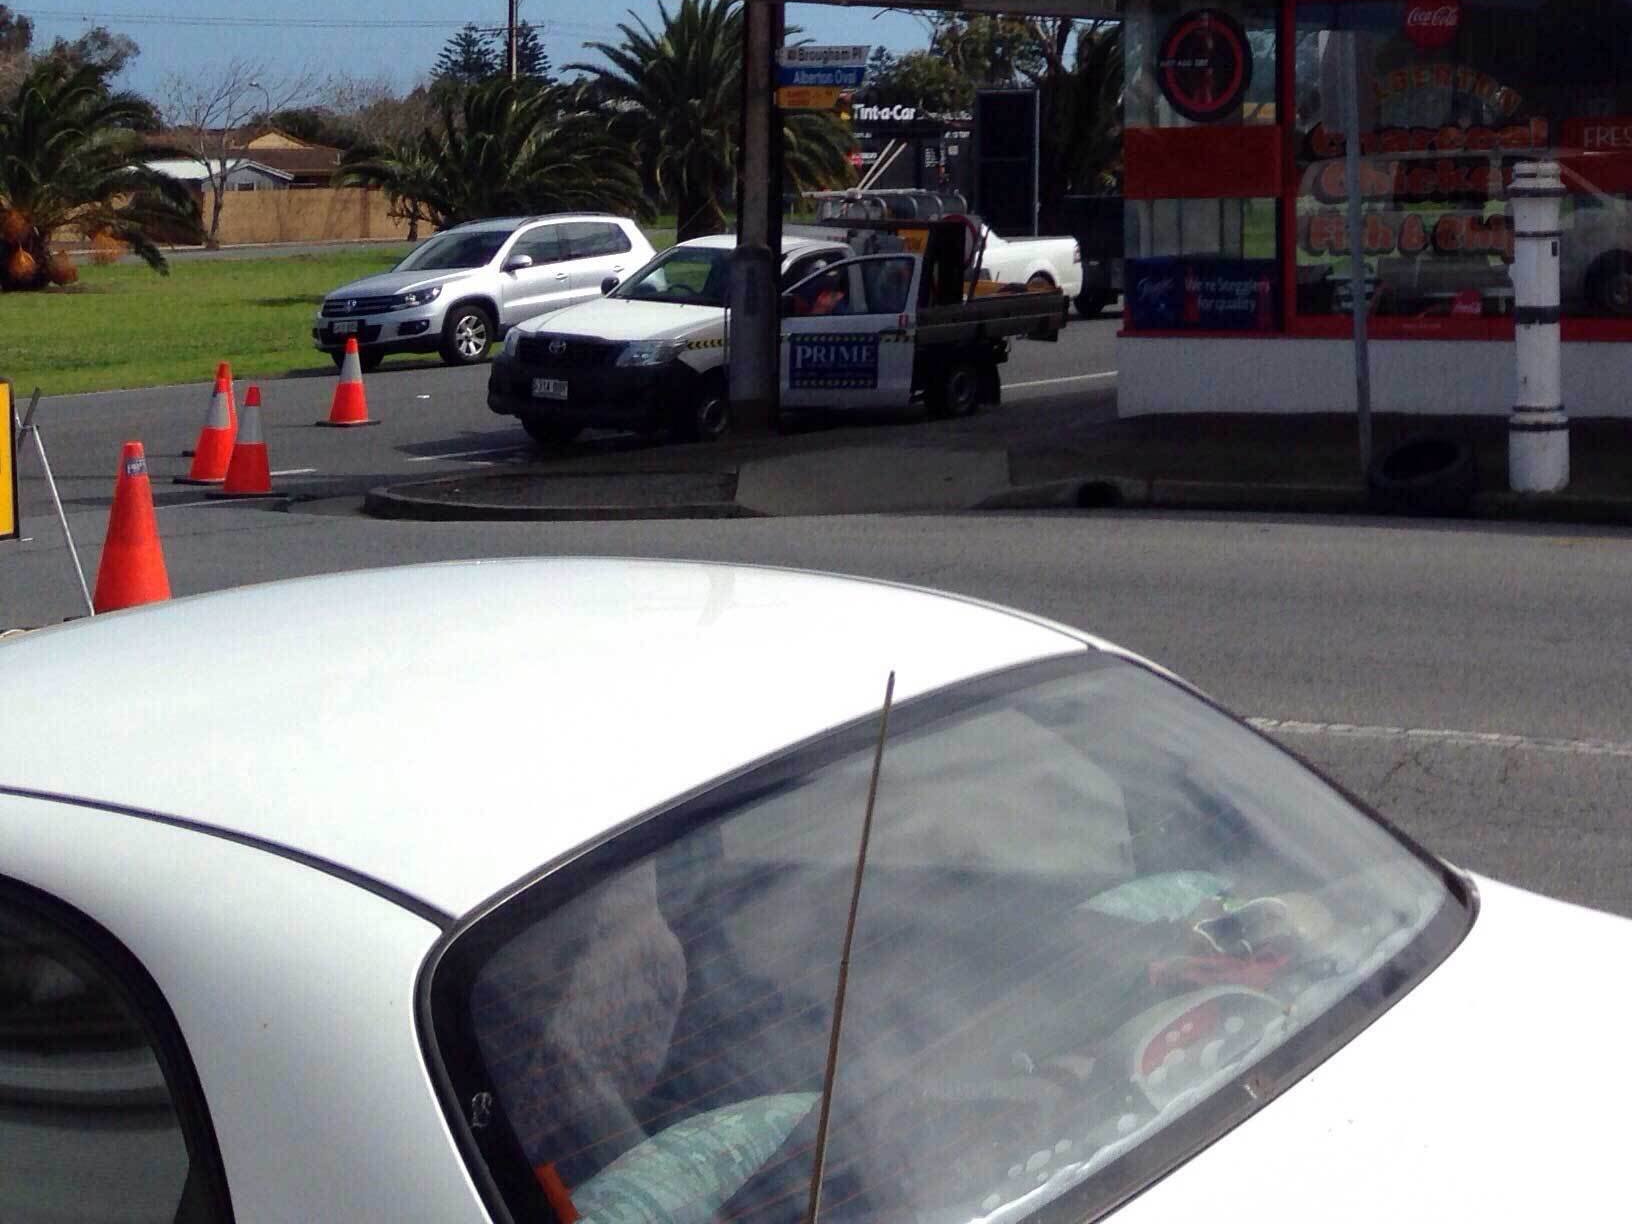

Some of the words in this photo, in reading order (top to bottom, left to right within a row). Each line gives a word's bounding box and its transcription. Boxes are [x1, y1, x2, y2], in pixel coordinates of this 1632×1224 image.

[799, 47, 851, 64] Brougham
[793, 71, 833, 85] Alberton
[835, 69, 858, 85] Oval
[795, 344, 874, 369] PRIME
